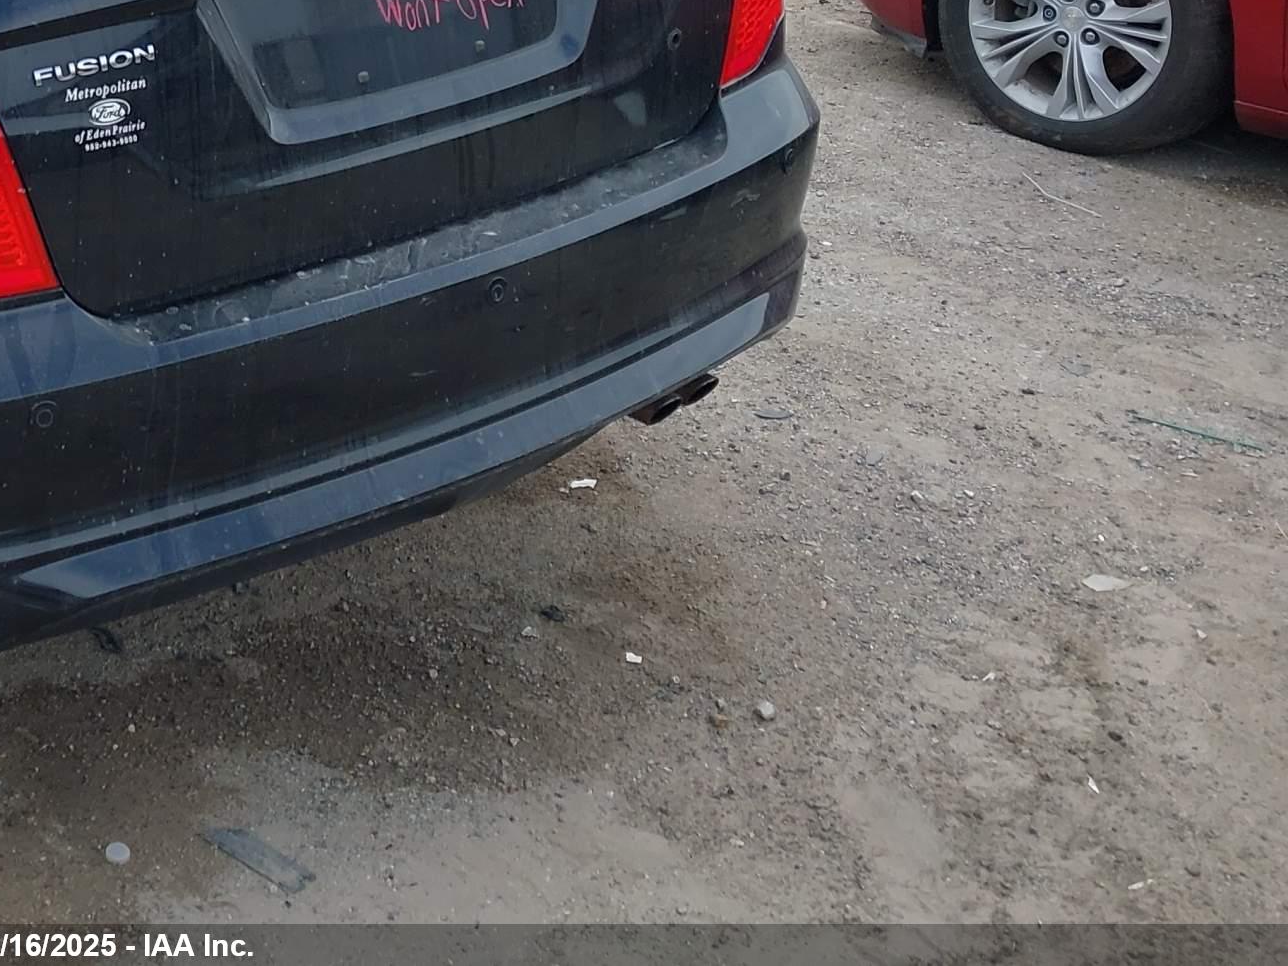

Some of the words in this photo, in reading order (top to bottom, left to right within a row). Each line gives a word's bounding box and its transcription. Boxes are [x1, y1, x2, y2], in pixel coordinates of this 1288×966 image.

[33, 44, 155, 86] FUSION
[64, 77, 147, 103] Metropolitan
[74, 130, 86, 144] of
[86, 128, 112, 141] Eden
[112, 119, 146, 136] Prairie
